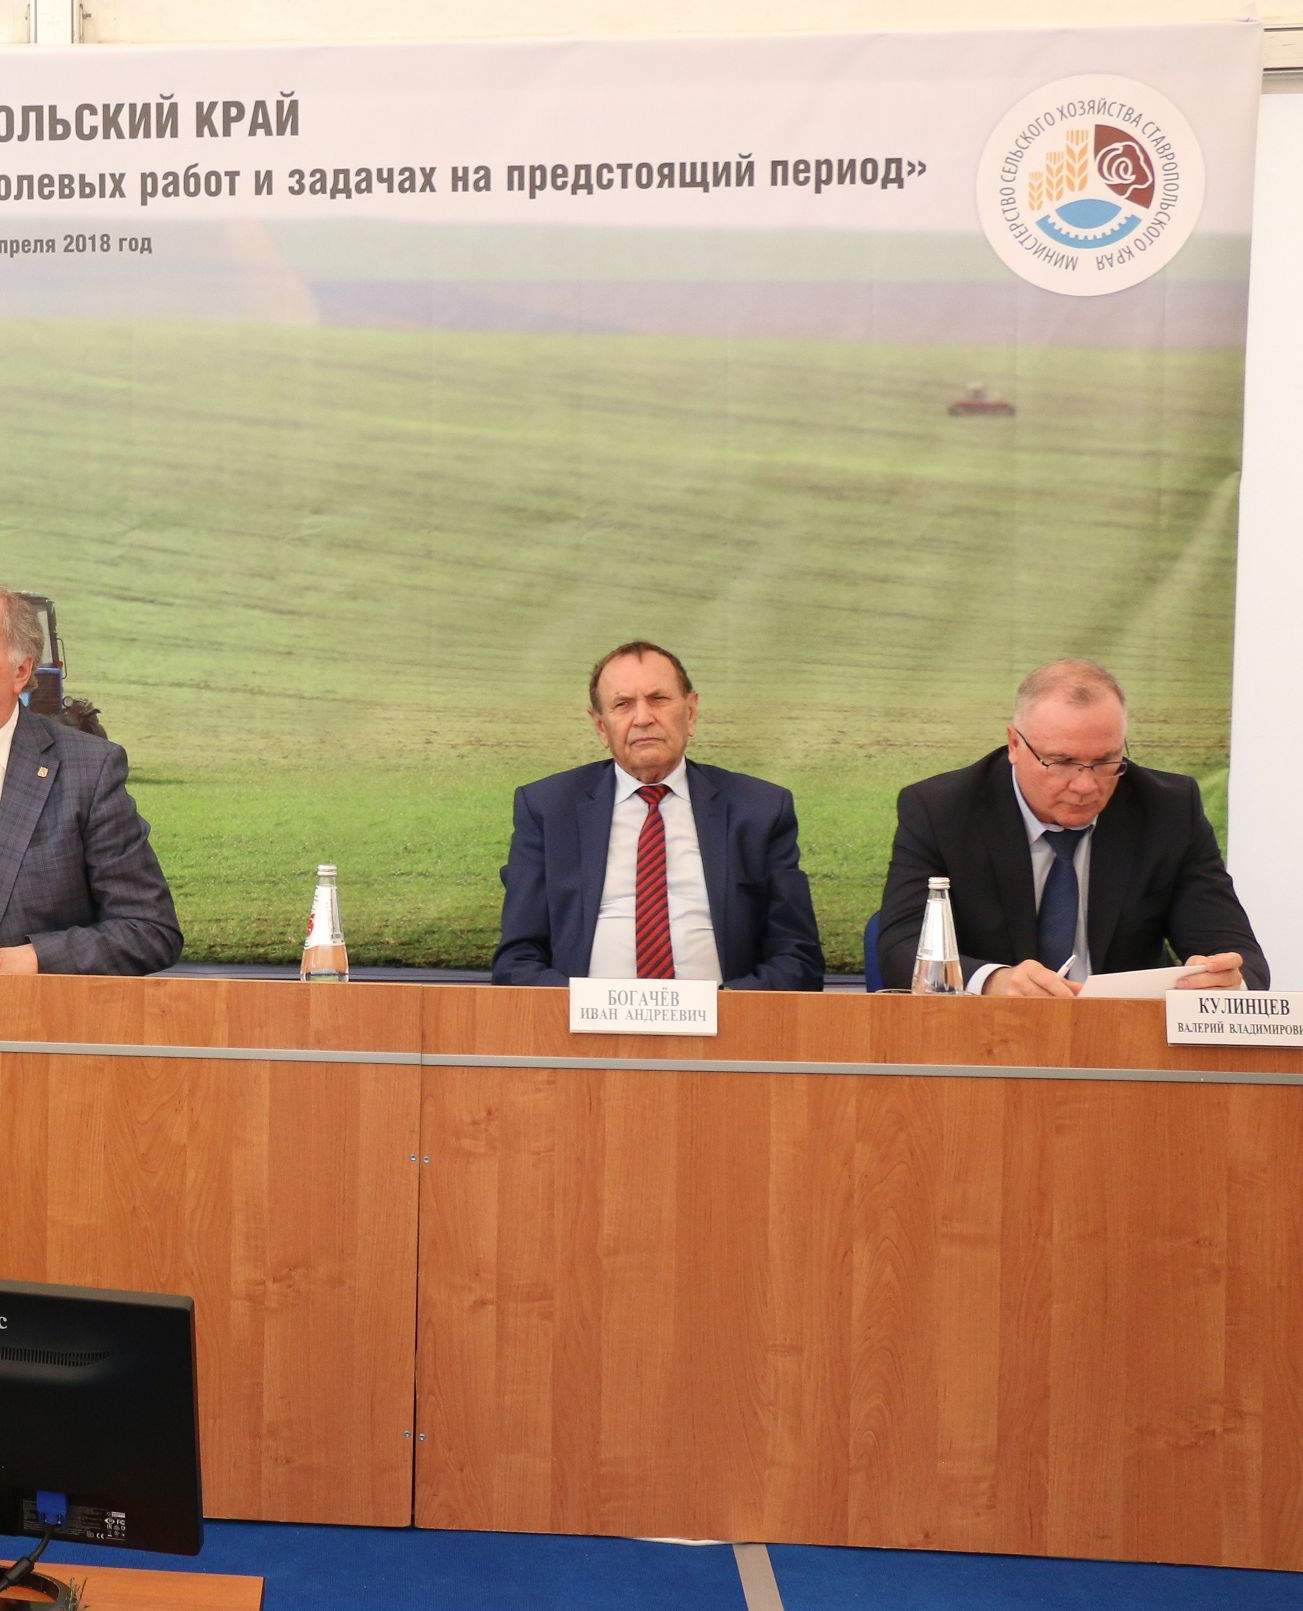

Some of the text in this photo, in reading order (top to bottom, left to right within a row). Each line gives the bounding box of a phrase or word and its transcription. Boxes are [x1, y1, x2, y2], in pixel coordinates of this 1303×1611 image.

[195, 90, 301, 139] КРАЙ
[140, 162, 241, 207] работ
[254, 169, 274, 197] и
[287, 166, 438, 201] задачах
[451, 165, 492, 193] на
[506, 152, 756, 200] предстоящий
[770, 153, 928, 195] период»
[999, 97, 1180, 272] МИНИСТЕРСТВО СЕЛЬСКОГО ХОЗЯЙСТВА СТАВРОПОЛЬСКОГО КРАЯ
[63, 233, 112, 254] 2018
[118, 235, 153, 256] год
[607, 987, 680, 1007] БОГАЧЁВ
[1199, 997, 1290, 1018] КУЛИНЦЕВ
[581, 1007, 707, 1022] ИВАН АНДРЕЕВИЧ
[1178, 1021, 1224, 1034] ВАЛЕРИЙ
